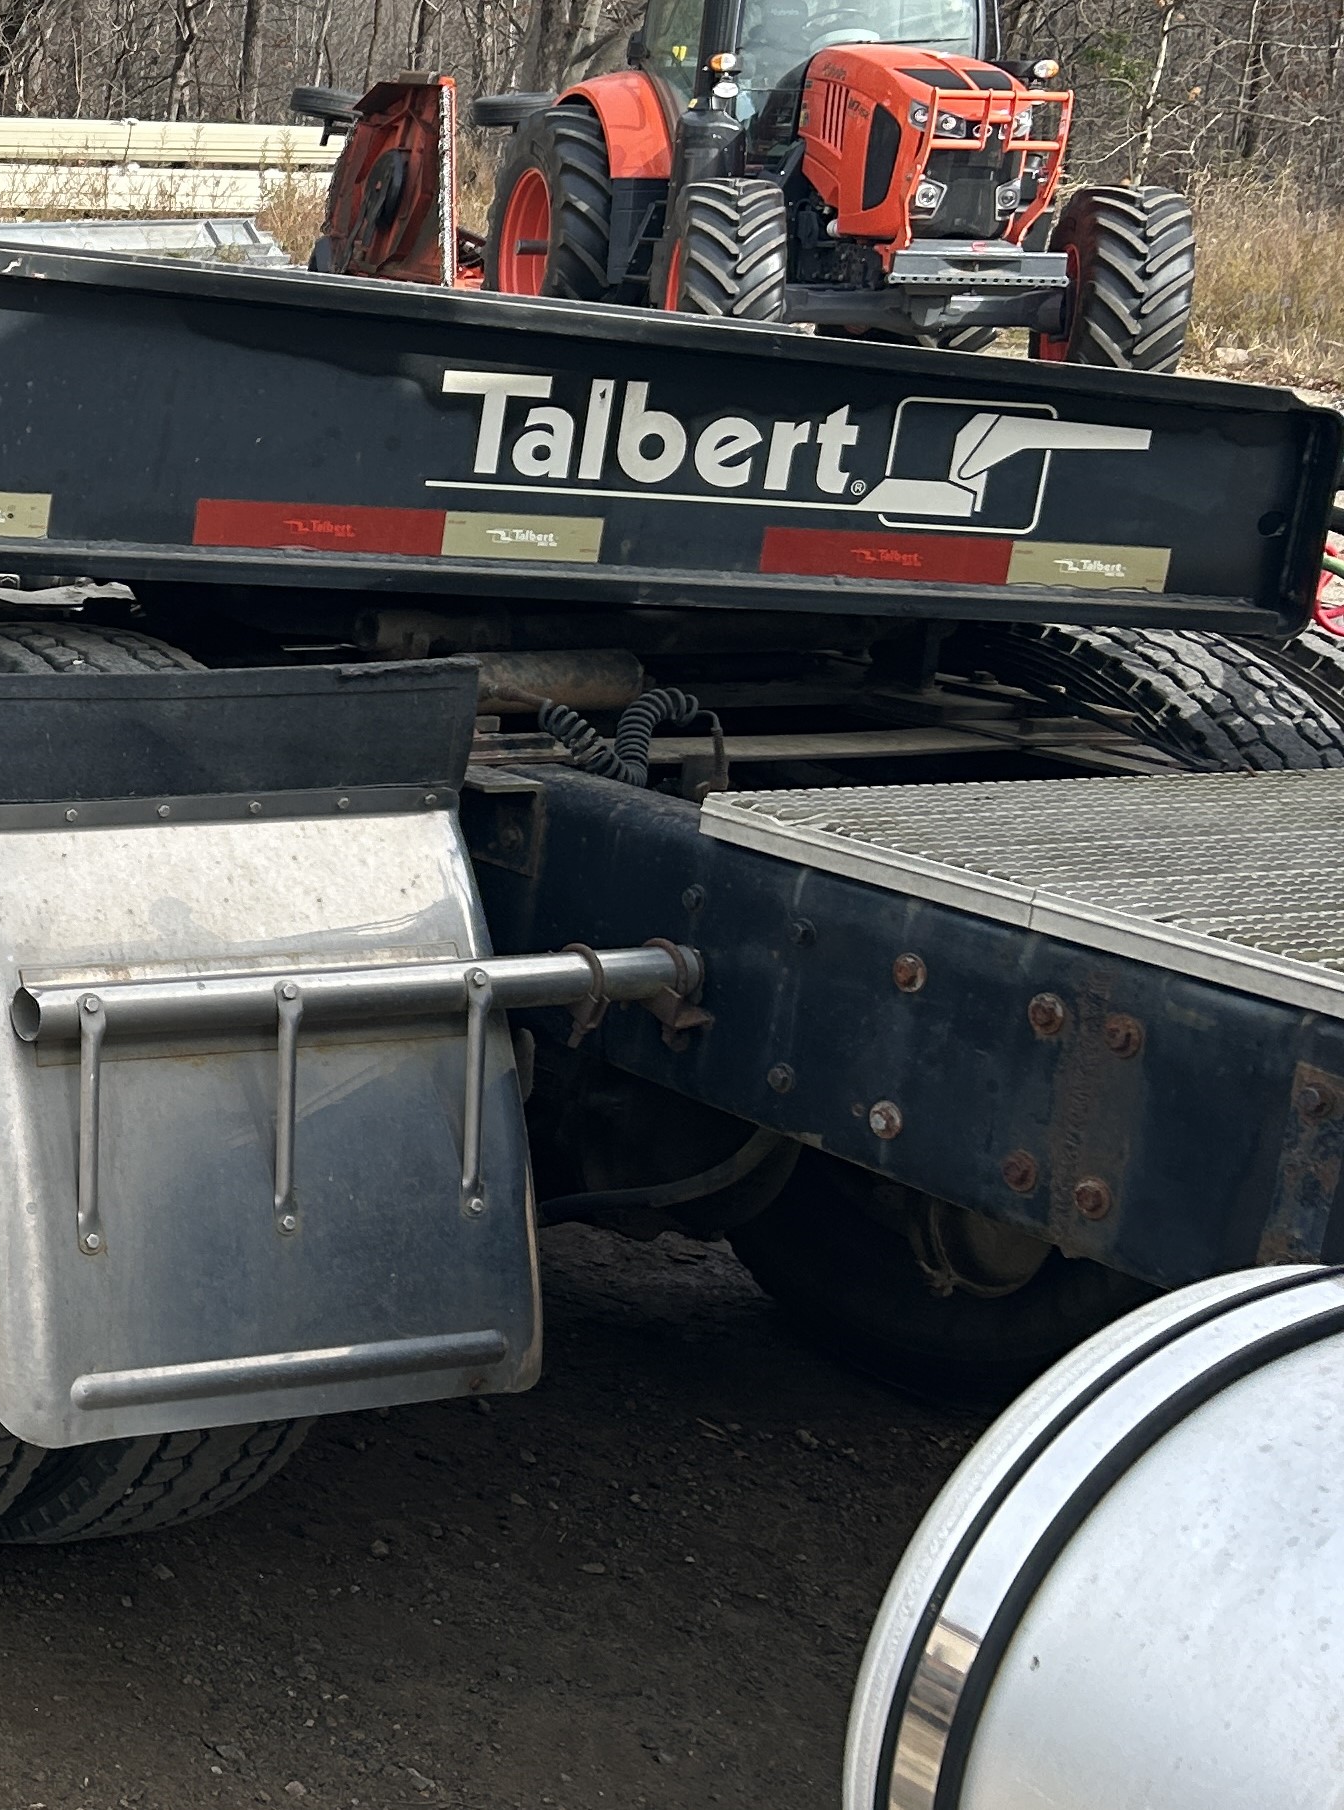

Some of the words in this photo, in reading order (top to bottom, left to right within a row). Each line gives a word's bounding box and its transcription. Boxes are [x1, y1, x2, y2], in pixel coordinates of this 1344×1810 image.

[443, 370, 858, 494] Talbert
[512, 529, 554, 542] Talbert
[1079, 559, 1122, 572] Talbert
